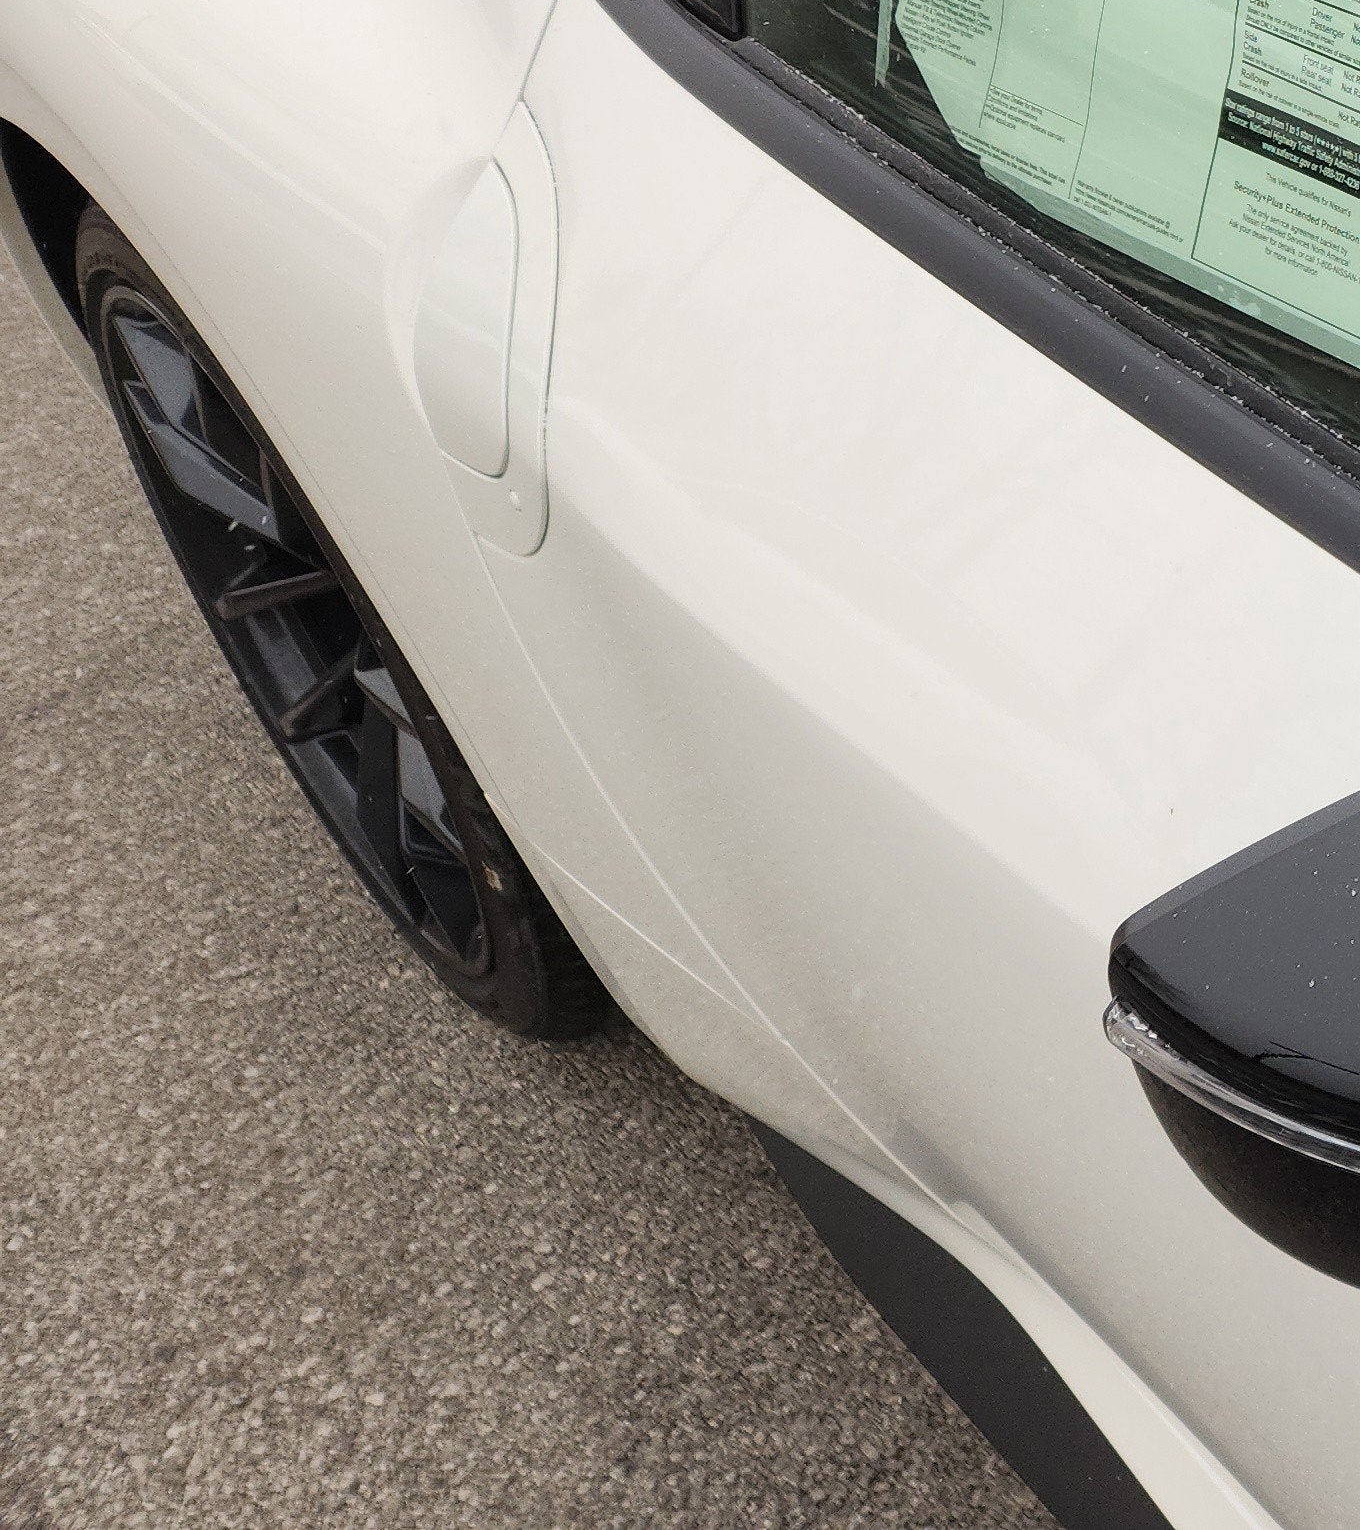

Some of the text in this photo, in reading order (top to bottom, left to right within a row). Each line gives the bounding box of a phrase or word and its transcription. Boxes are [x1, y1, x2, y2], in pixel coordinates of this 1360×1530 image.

[1312, 6, 1333, 22] Driver
[1310, 18, 1345, 40] Passenger
[1240, 67, 1270, 88] Rollover
[1342, 70, 1355, 82] Not
[1340, 82, 1352, 96] Not
[1338, 110, 1350, 123] Not
